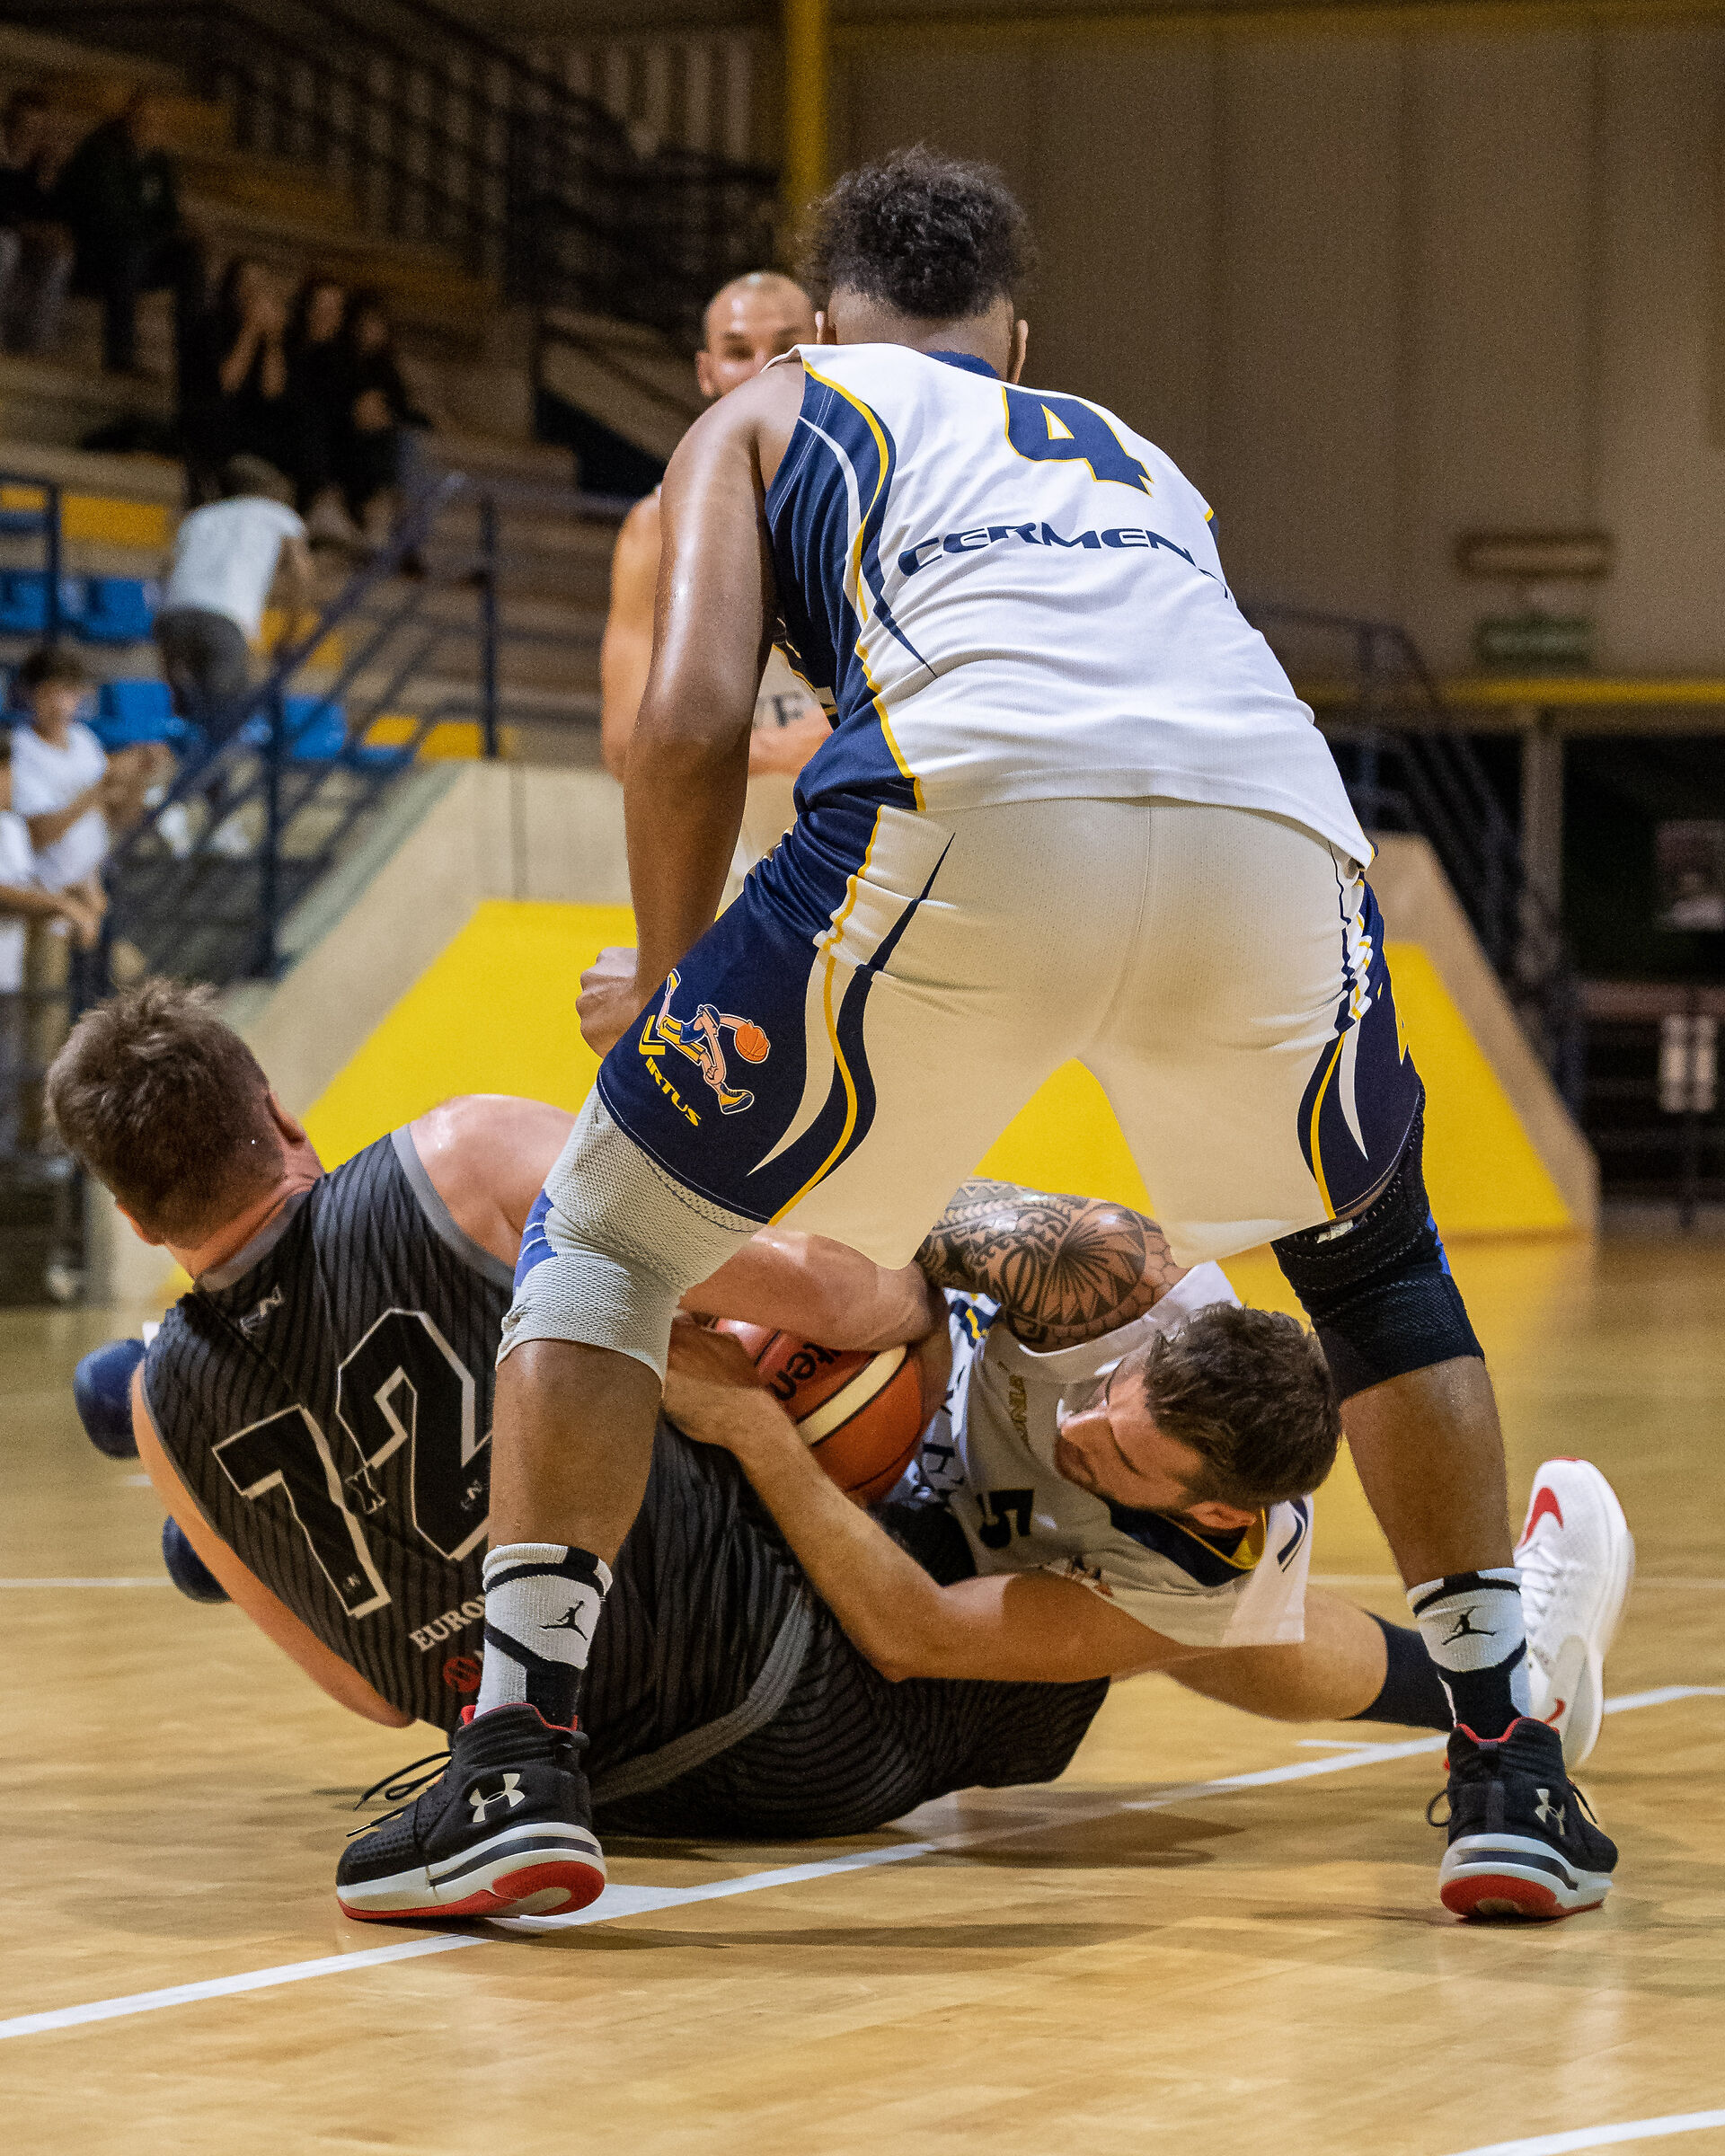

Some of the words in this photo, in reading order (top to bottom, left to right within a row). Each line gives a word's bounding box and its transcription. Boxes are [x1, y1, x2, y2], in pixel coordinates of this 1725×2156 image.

[1000, 385, 1154, 498] 4
[898, 522, 1228, 601] CERMEN
[976, 1488, 1036, 1551] 5
[409, 1594, 486, 1653] EURO
